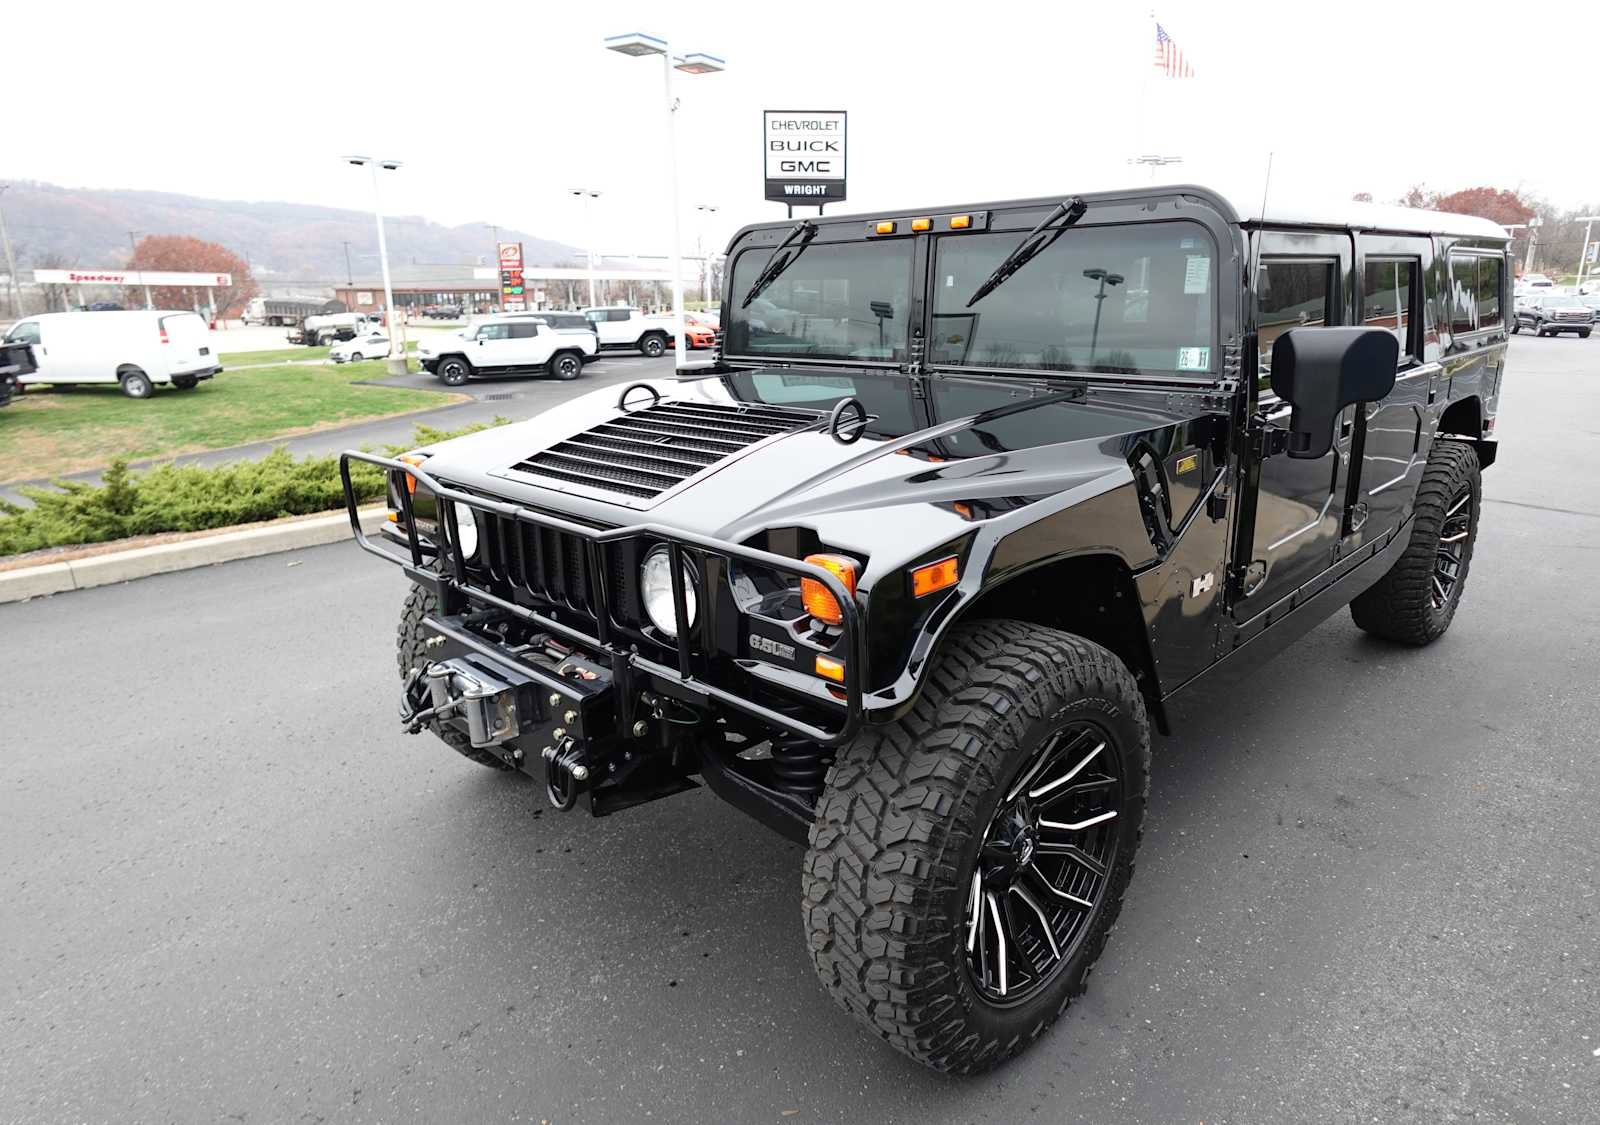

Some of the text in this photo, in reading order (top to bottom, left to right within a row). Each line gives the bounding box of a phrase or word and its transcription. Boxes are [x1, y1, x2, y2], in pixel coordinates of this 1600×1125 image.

[771, 120, 839, 131] CHEVROLET
[770, 140, 839, 152] BUICK
[780, 160, 831, 172] GMC
[784, 184, 827, 195] WRIGHT
[70, 273, 124, 283] Speedway
